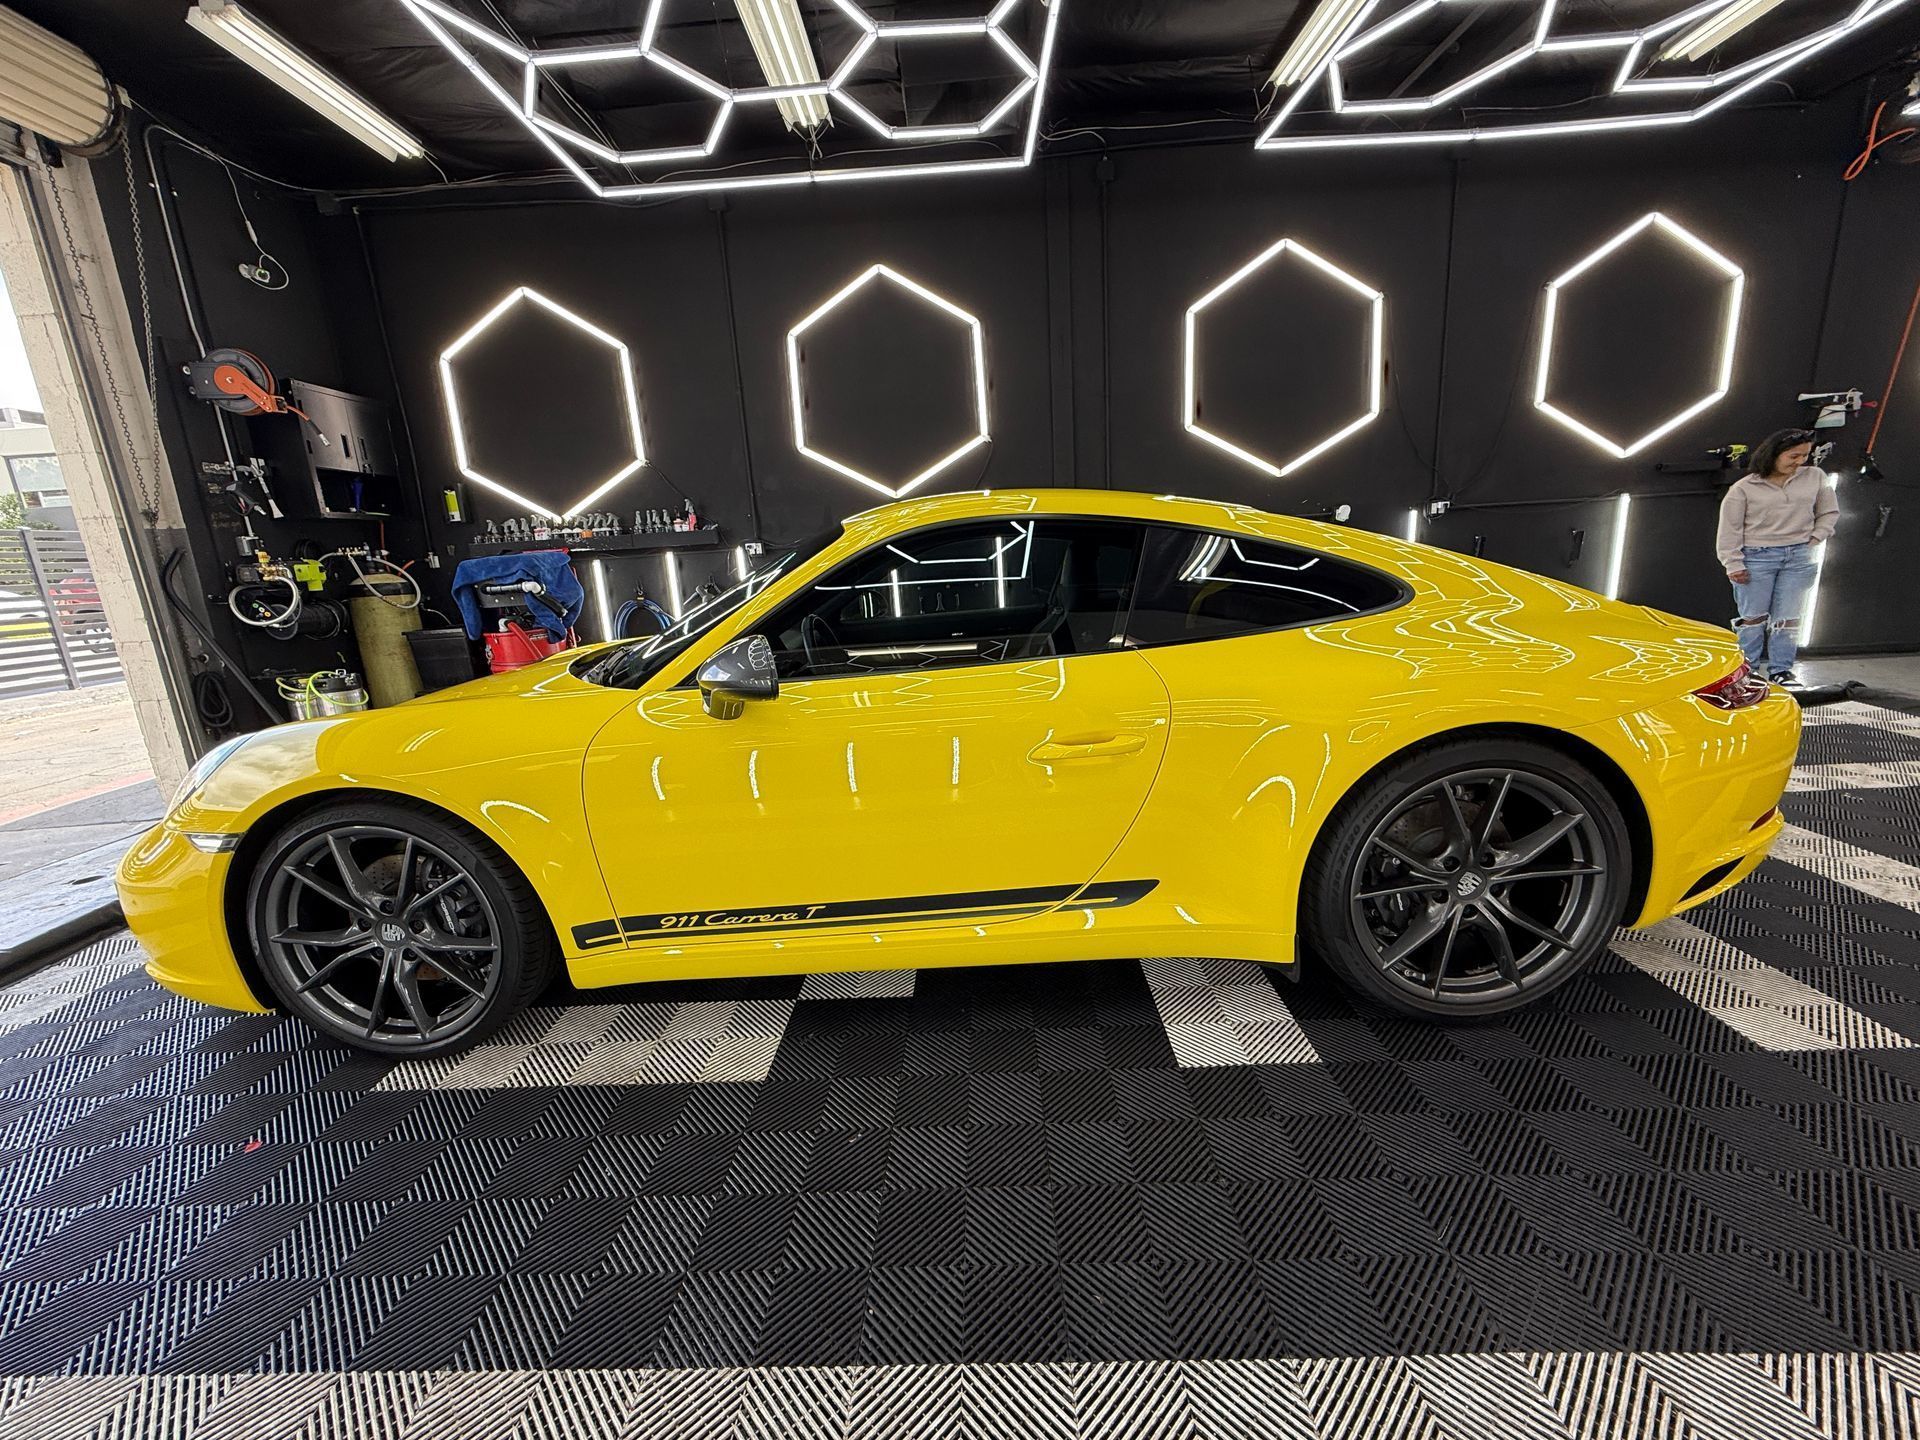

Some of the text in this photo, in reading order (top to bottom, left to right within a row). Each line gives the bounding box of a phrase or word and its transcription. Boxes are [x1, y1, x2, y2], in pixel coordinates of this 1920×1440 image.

[660, 905, 826, 929] 911 Carrera T
